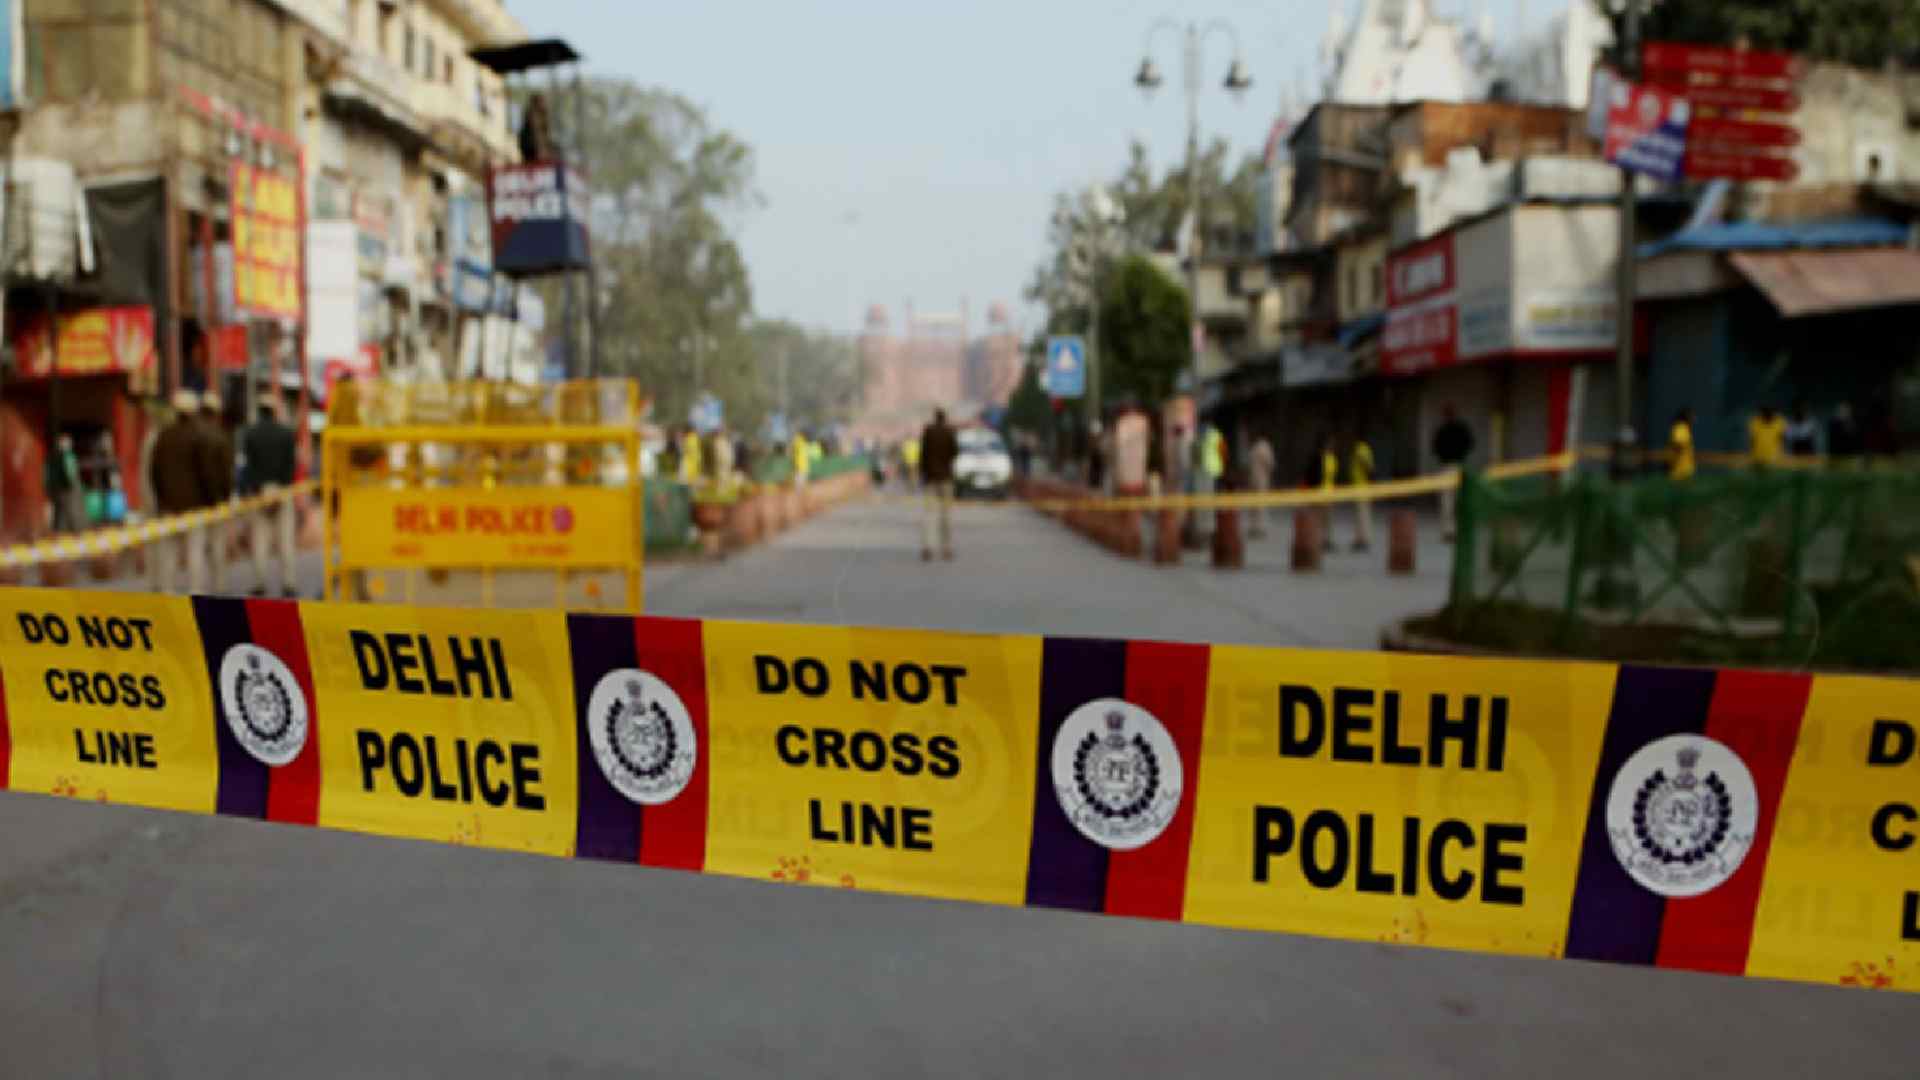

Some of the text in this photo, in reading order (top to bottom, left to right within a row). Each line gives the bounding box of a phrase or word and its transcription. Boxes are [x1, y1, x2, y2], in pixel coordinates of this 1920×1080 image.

[465, 505, 546, 536] POLICE
[17, 612, 153, 652] DO NOT
[44, 668, 167, 711] CROSS
[349, 629, 513, 701] DELHI
[753, 654, 968, 707] DO NOT
[74, 728, 158, 769] LINE
[776, 724, 961, 779] CROSS
[1278, 684, 1510, 772] DELHI
[1866, 719, 1920, 768] D
[356, 729, 547, 812] POLICE
[808, 799, 934, 852] LINE
[1252, 805, 1528, 906] POLICE
